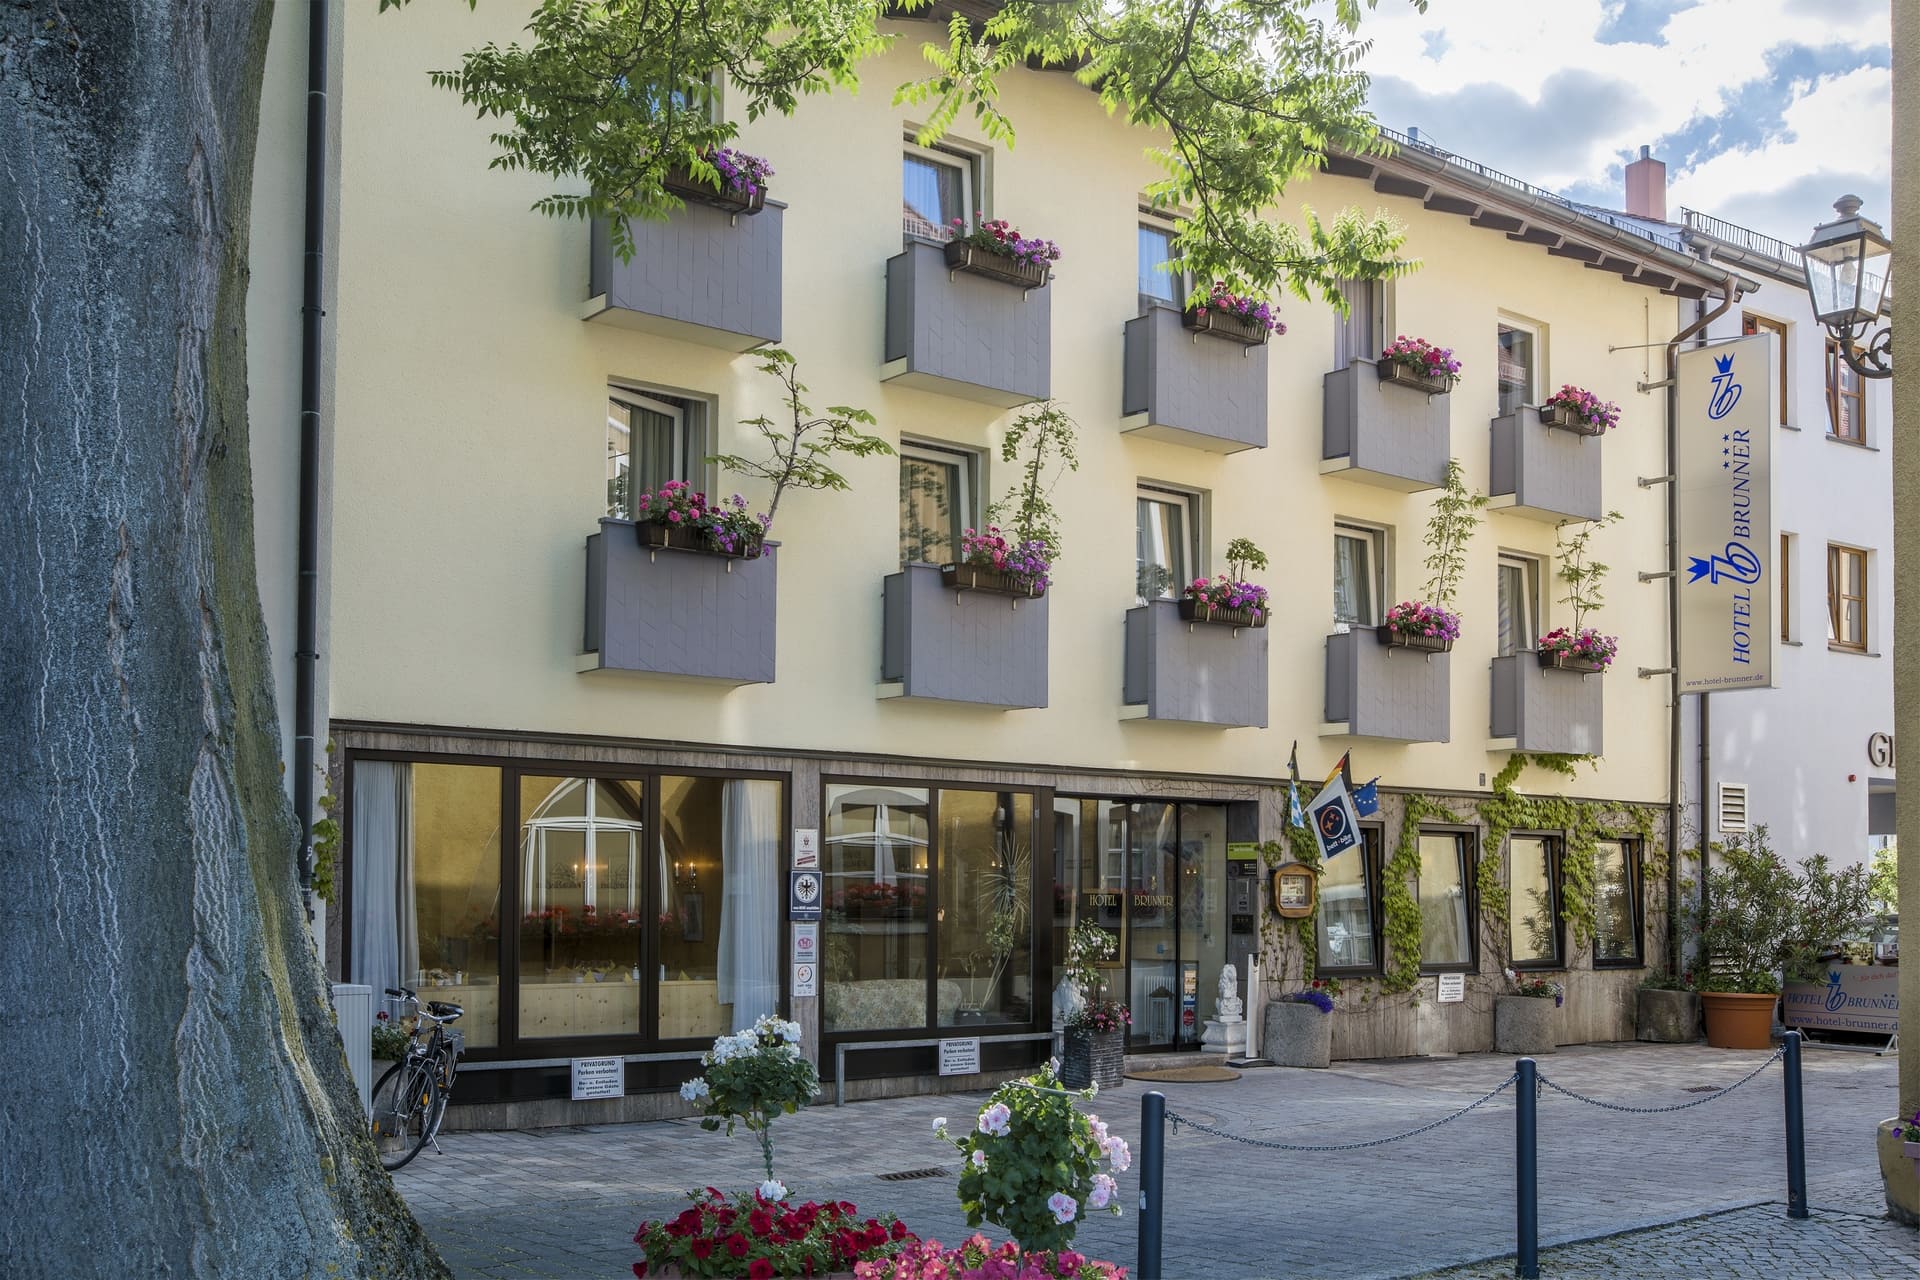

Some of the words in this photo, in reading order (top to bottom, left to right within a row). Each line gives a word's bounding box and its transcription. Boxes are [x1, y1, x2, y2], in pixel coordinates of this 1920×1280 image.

[1733, 428, 1751, 539] BRUNNER
[1732, 588, 1751, 665] HOTEL
[1685, 673, 1764, 687] www.hotel-brunner.de
[1089, 894, 1117, 907] HOTEL
[1134, 895, 1174, 907] BRUNNER
[1787, 992, 1824, 1006] HOTEL
